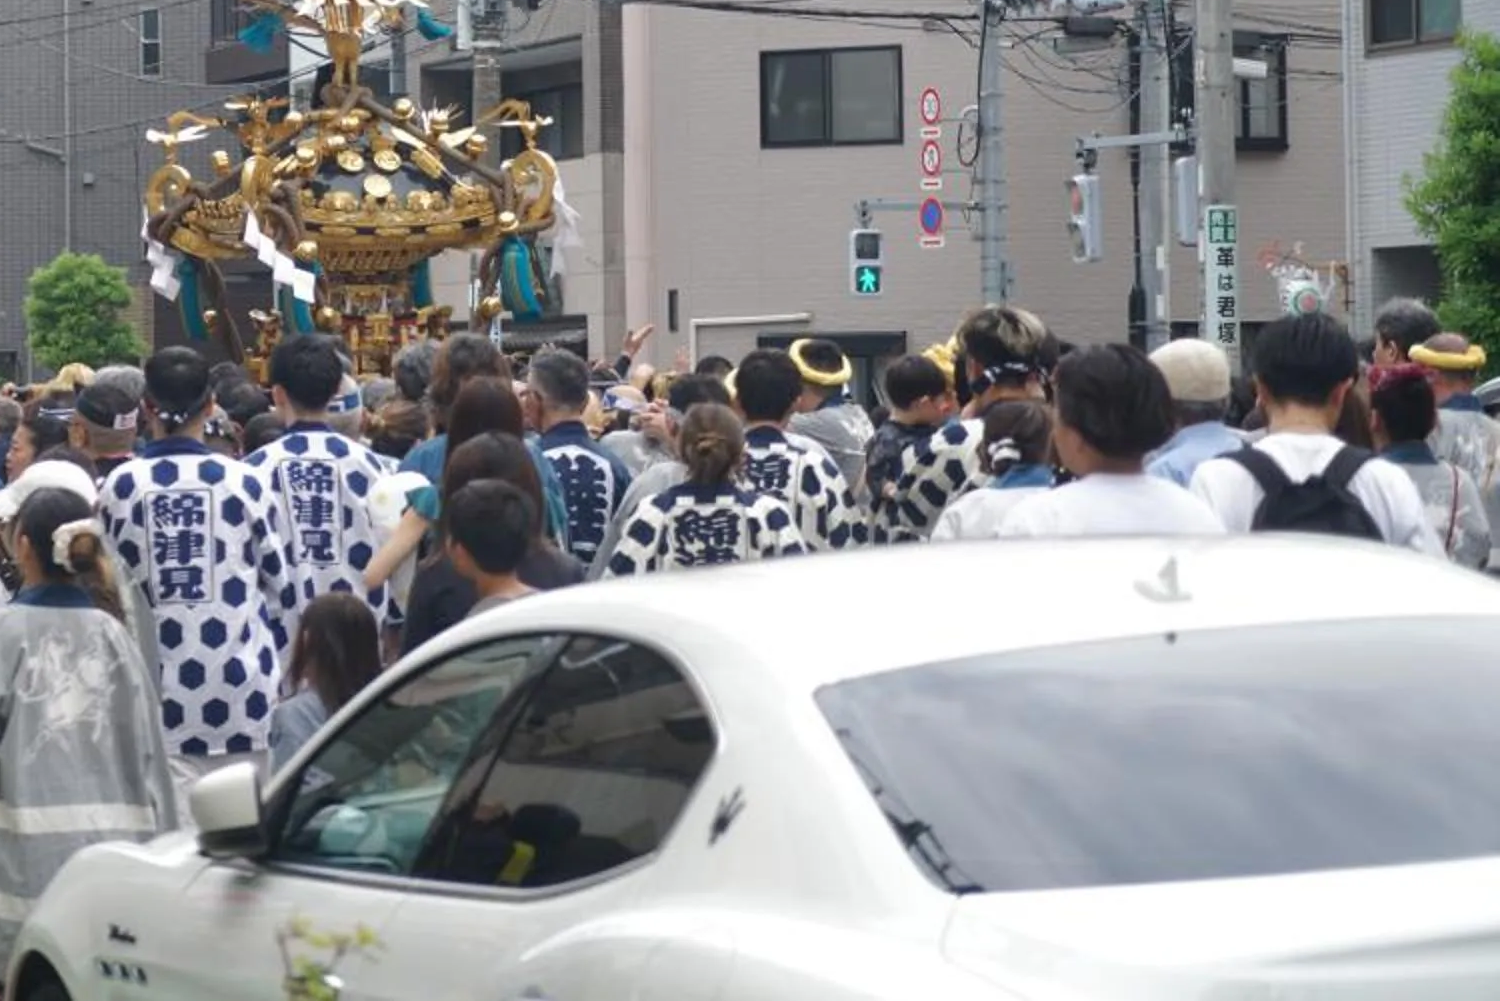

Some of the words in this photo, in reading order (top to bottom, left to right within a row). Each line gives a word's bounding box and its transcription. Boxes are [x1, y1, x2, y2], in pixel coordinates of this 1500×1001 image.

[152, 494, 205, 600] 綿津見
[287, 460, 335, 563] 綿津見
